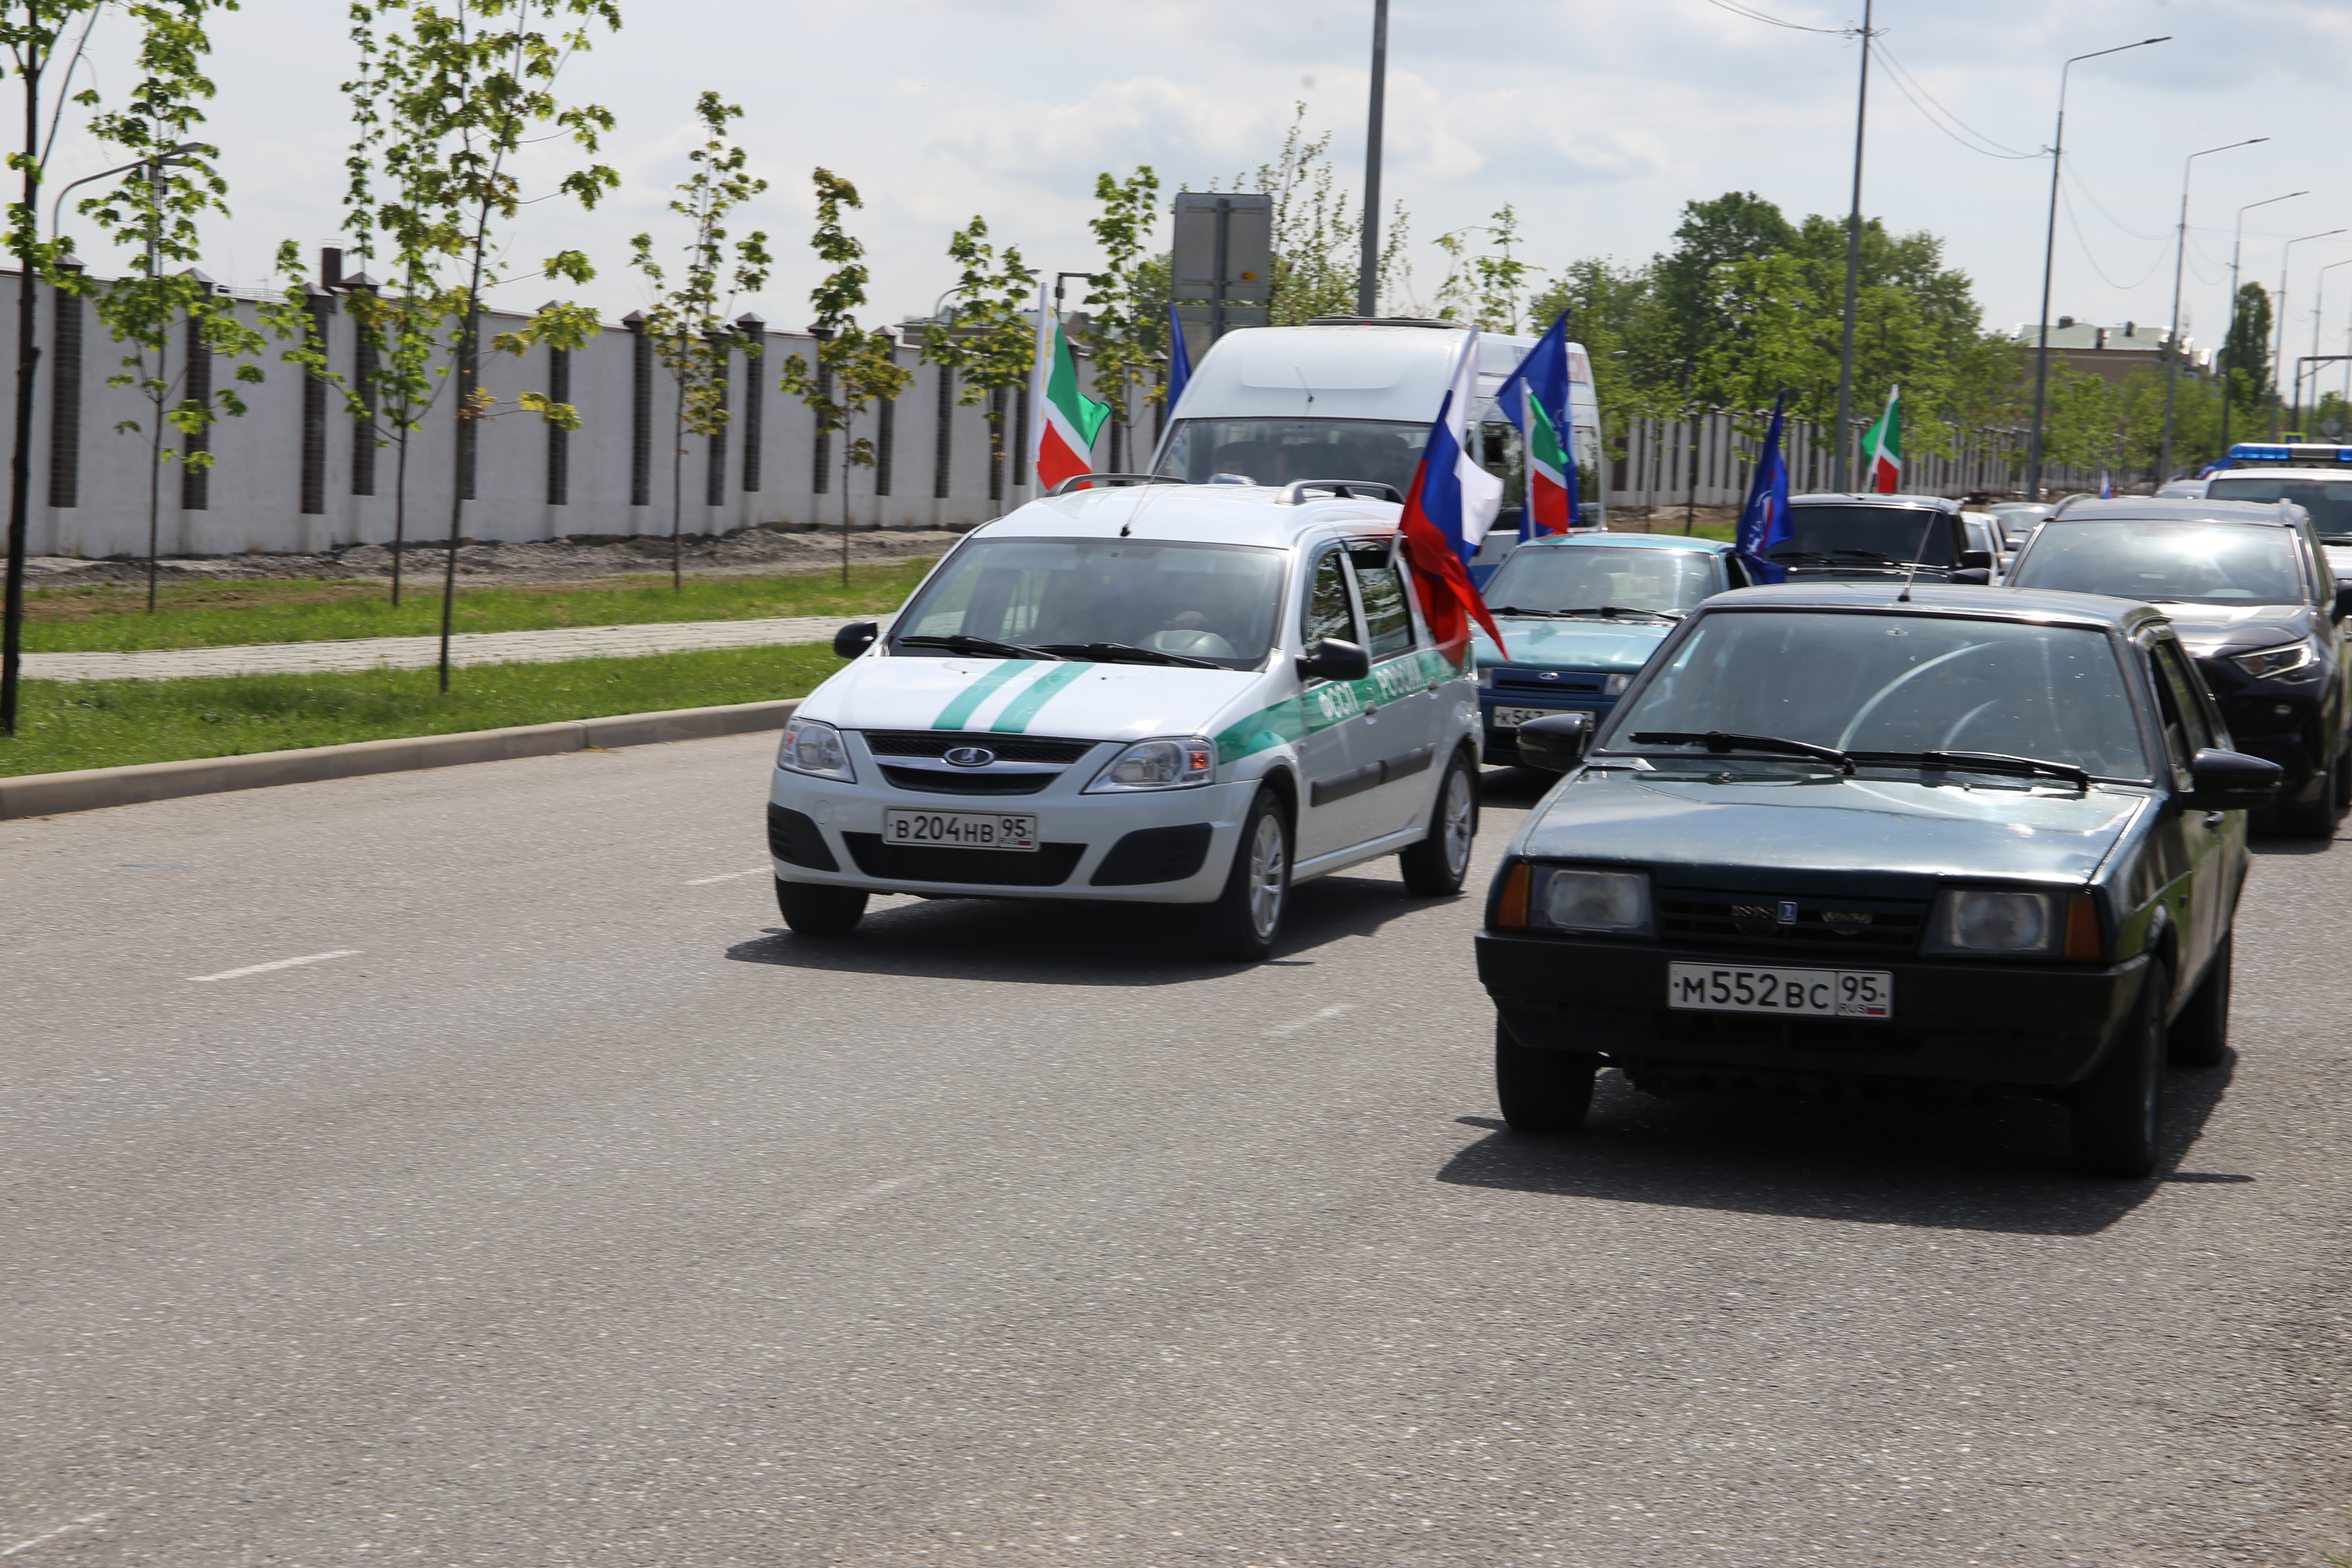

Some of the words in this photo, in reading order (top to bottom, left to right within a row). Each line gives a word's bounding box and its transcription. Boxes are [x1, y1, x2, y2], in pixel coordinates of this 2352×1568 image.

[896, 815, 994, 842] В204НВ
[1002, 818, 1026, 837] 95
[1682, 970, 1829, 1009] М552ВС
[1841, 975, 1877, 1002] 95
[1839, 1003, 1867, 1014] RUS
